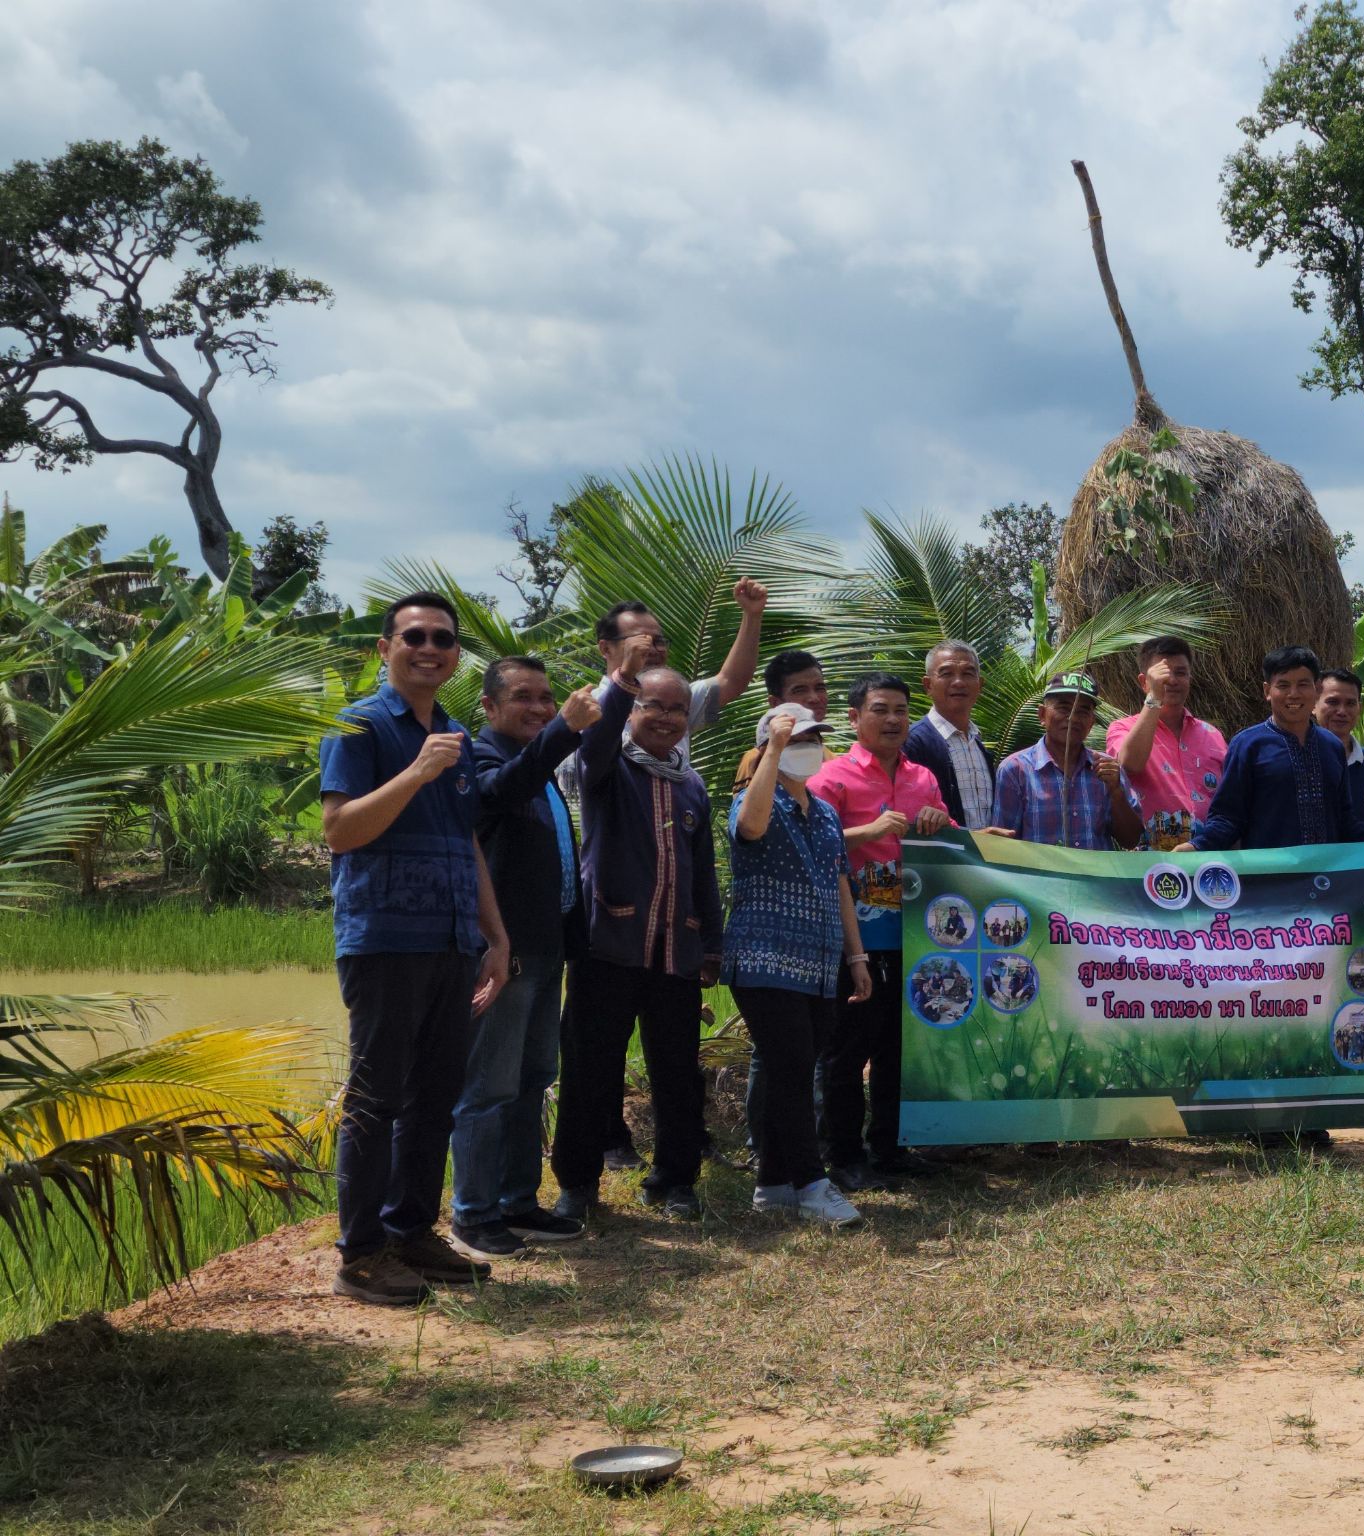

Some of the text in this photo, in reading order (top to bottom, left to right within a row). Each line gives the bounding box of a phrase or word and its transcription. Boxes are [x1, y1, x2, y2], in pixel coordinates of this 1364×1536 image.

[1048, 911, 1352, 951] กิจกรรมเอามื้อสามัคคี
[1078, 955, 1324, 988] ศูนย์เรียนรู้ชุมชนต้นแบบ
[1102, 990, 1145, 1019] โคก
[1151, 1000, 1212, 1019] หนอง
[1218, 1000, 1245, 1018] นา
[1250, 990, 1308, 1018] โมเดล
